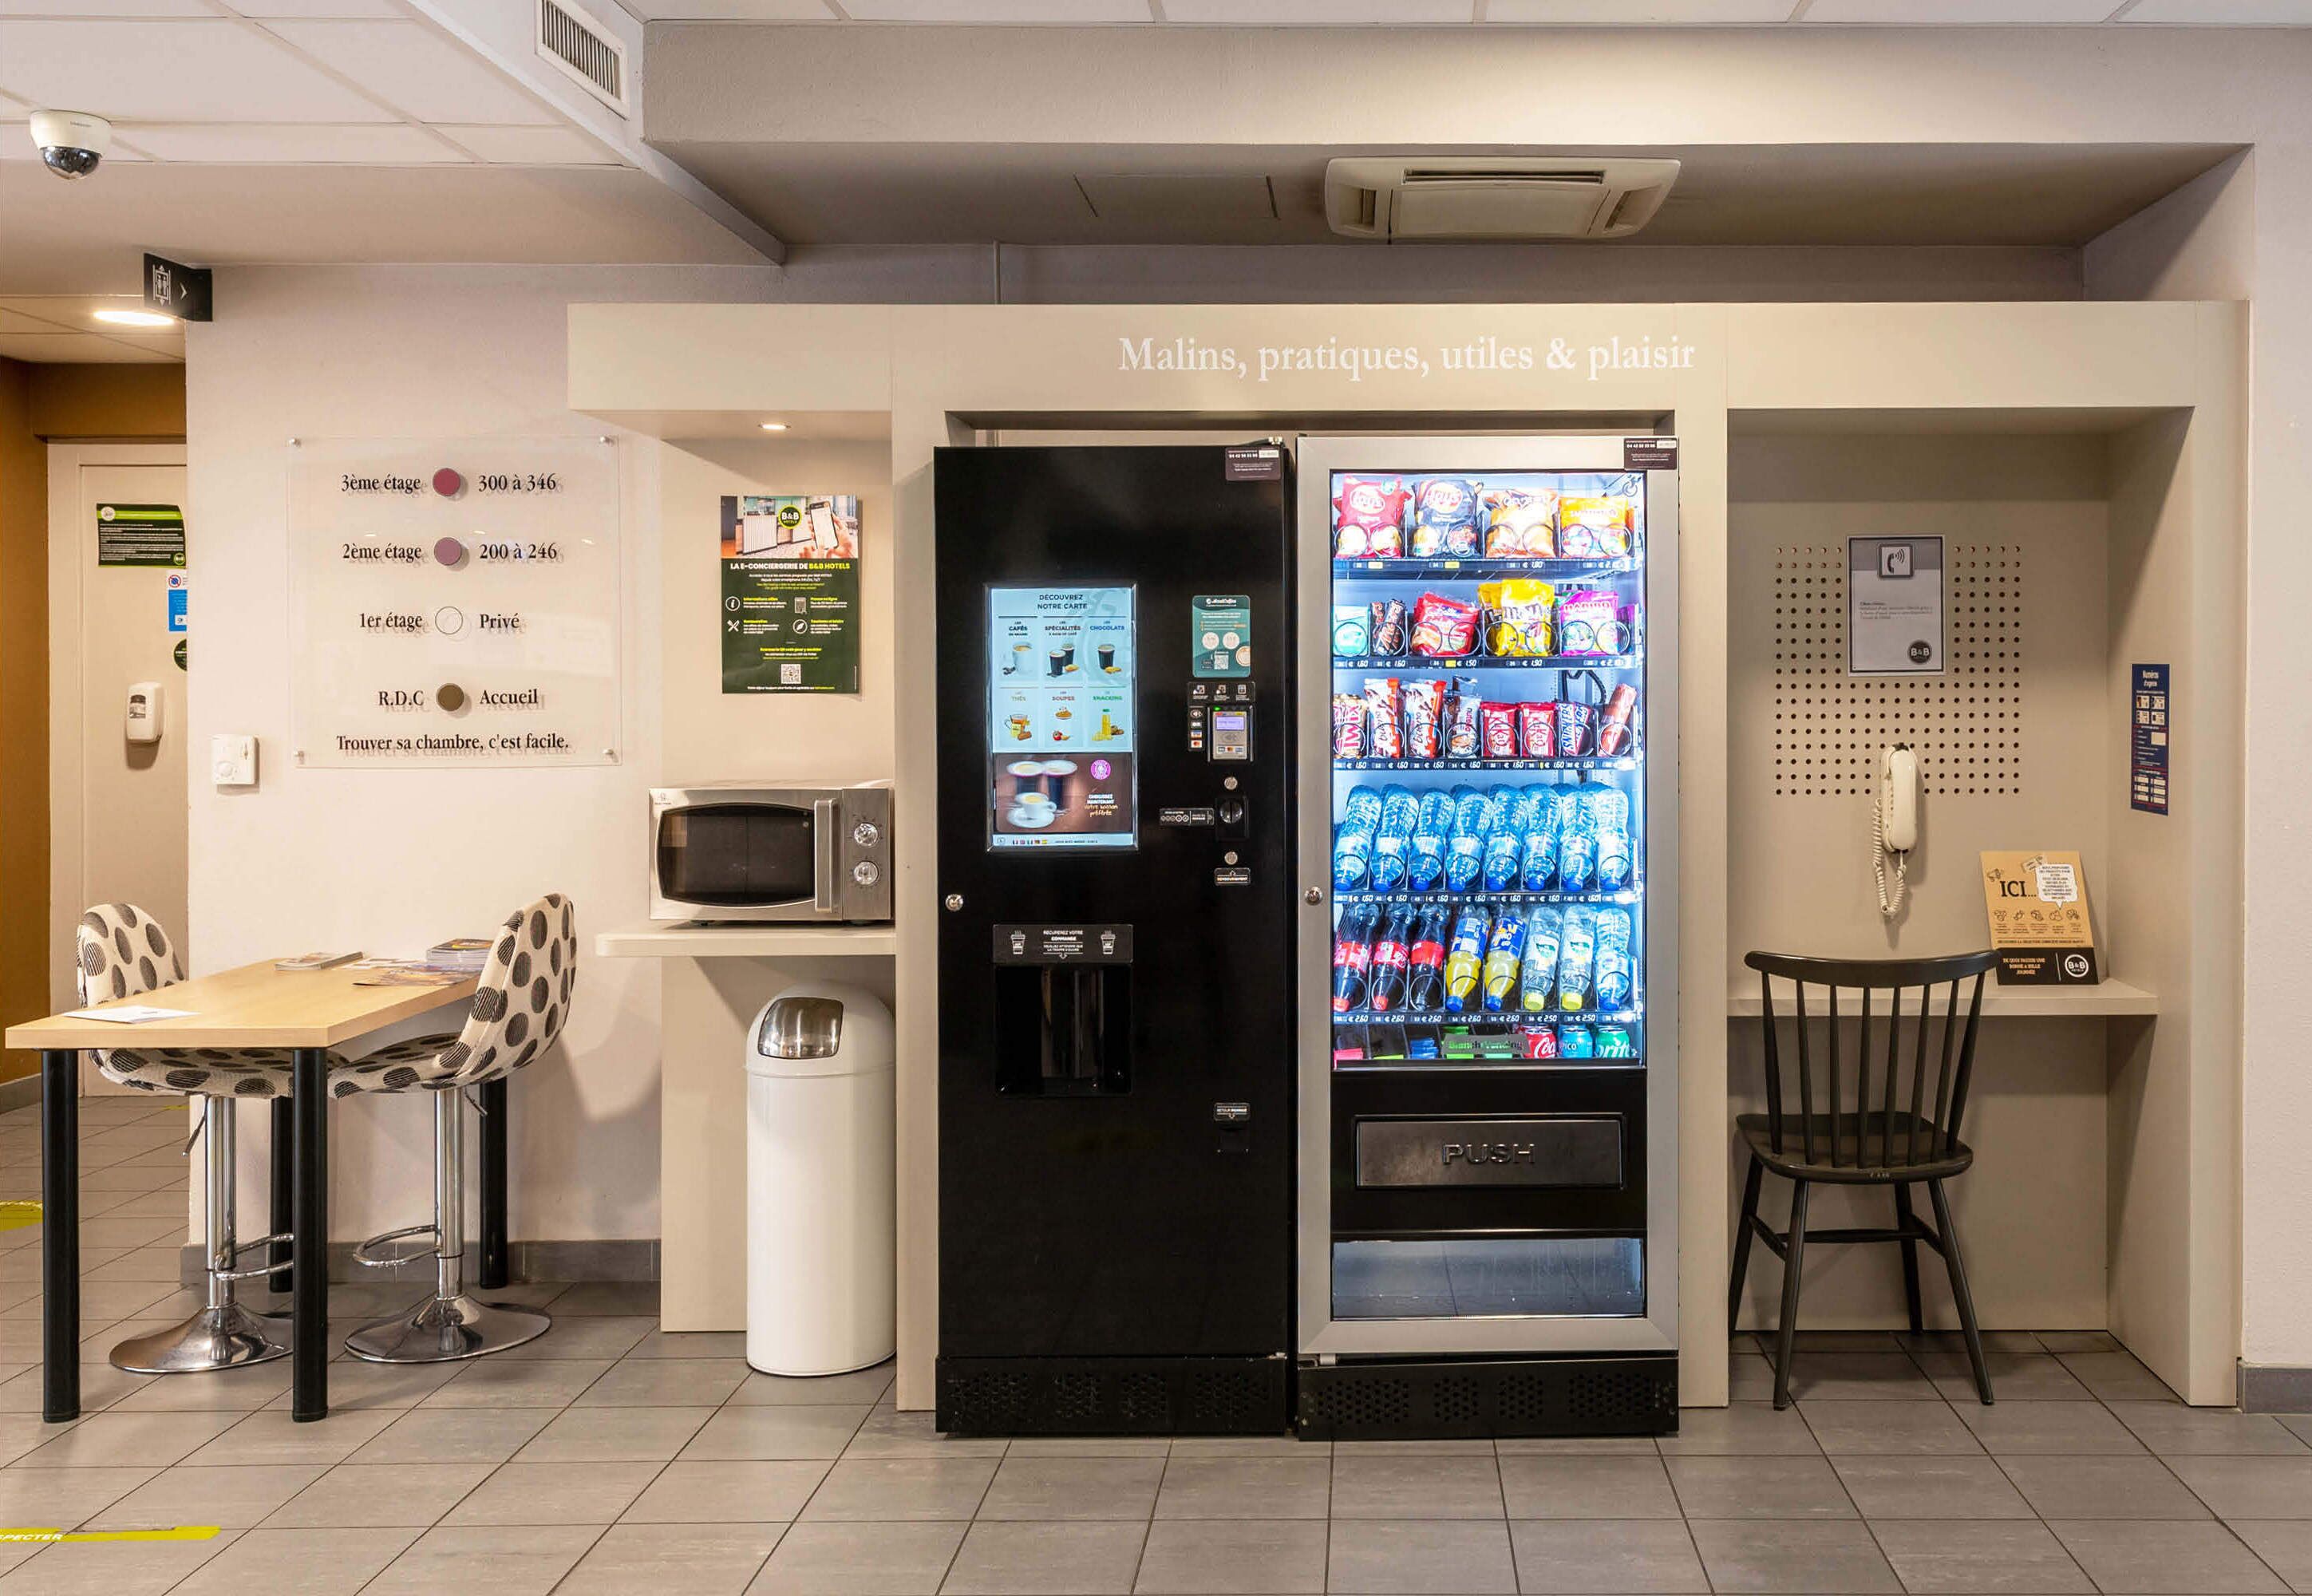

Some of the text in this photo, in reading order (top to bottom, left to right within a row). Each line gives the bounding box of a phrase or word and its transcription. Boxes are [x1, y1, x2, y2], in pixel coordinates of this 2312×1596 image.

[1119, 336, 1696, 381] Malins, pratiques, utiles & plaisir
[342, 474, 421, 493] 3ème étage
[479, 473, 556, 492] 300 à 346
[781, 512, 799, 520] B&B
[343, 543, 421, 563] 2ème étage
[480, 543, 557, 560] 200 à 246
[361, 613, 423, 632] 1er étage
[480, 612, 520, 629] Privé
[1911, 647, 1930, 656] B&B
[379, 690, 424, 705] R.D.C
[480, 689, 539, 705] Accueil
[336, 733, 569, 753] Trouver sa chambre, c'est facile.
[1999, 880, 2037, 897] ICI...
[2068, 961, 2085, 970] B&B
[1442, 1143, 1536, 1164] PUSH
